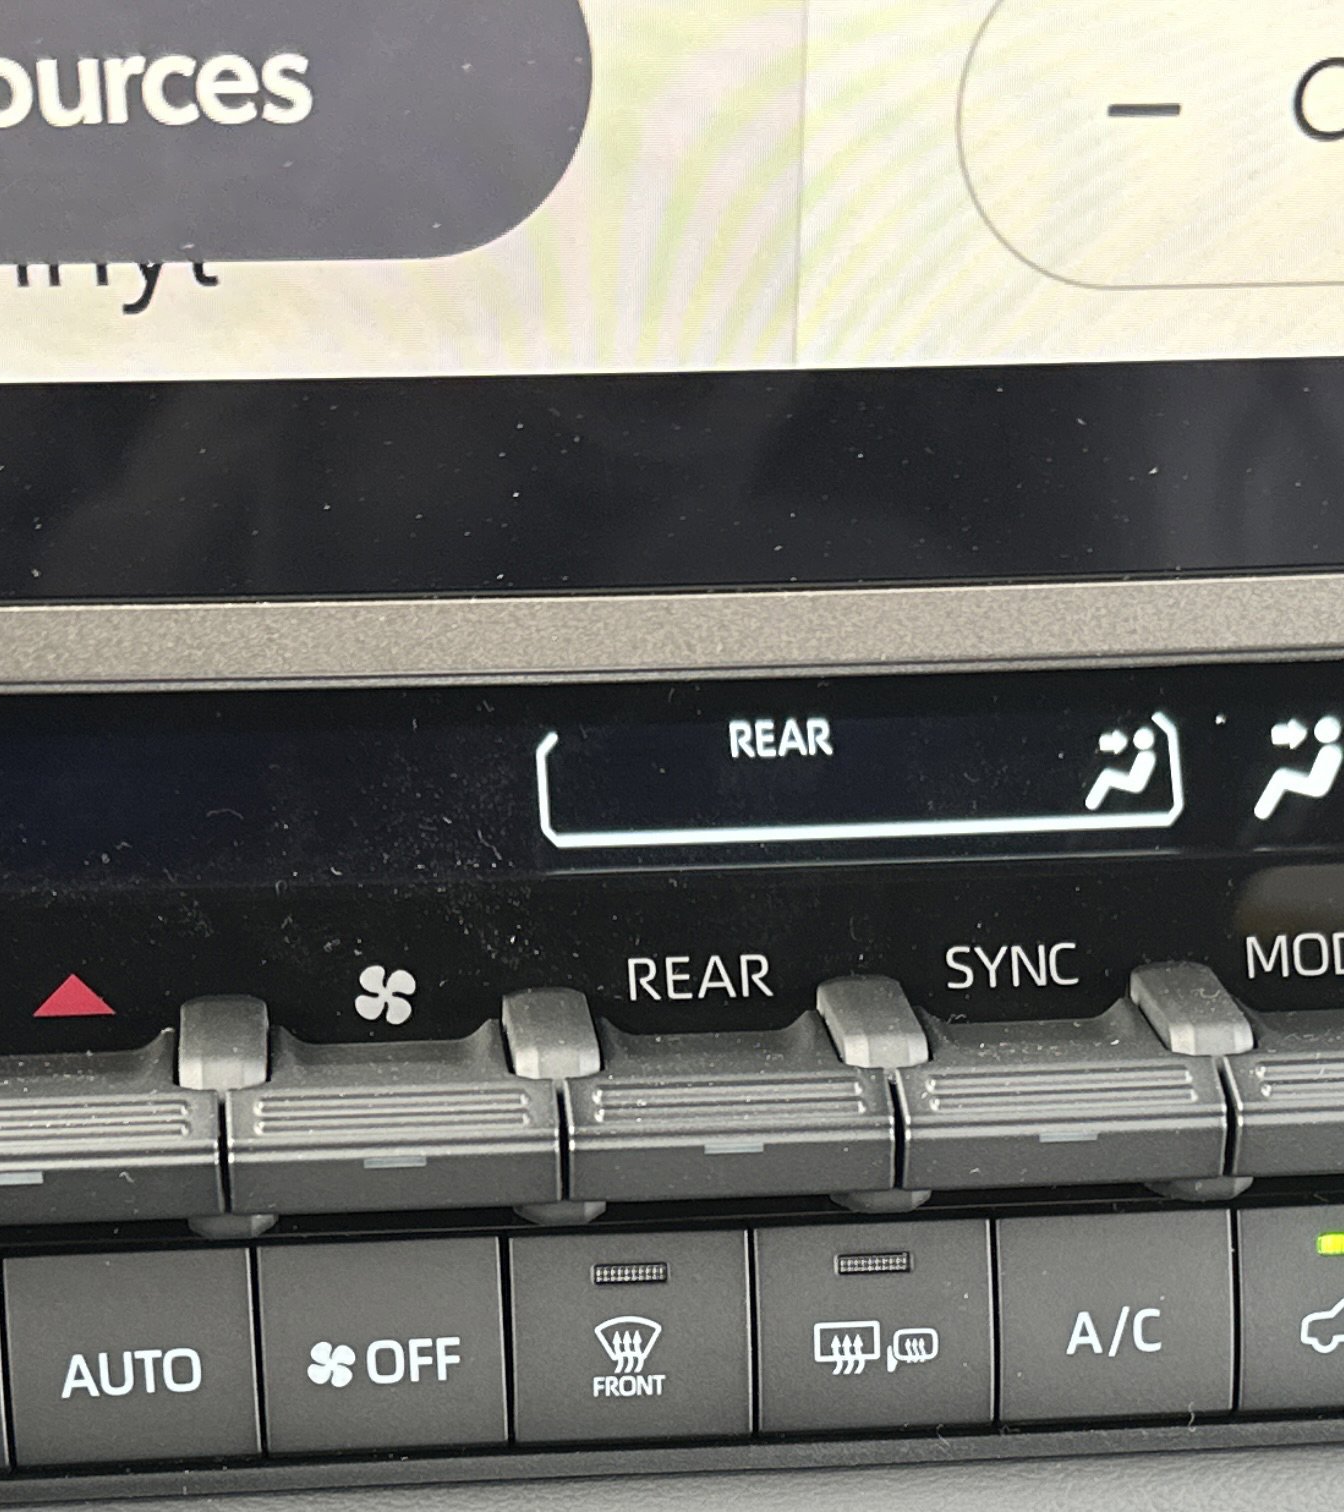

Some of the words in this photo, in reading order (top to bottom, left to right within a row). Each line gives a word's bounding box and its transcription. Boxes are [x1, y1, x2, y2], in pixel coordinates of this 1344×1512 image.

[728, 717, 834, 759] REAR
[626, 953, 775, 1001] REAR
[944, 942, 1080, 989] SYNC
[1065, 1304, 1163, 1358] A/C
[60, 1347, 203, 1399] AUTO
[365, 1336, 462, 1384] OFF
[591, 1372, 667, 1398] FRONT
